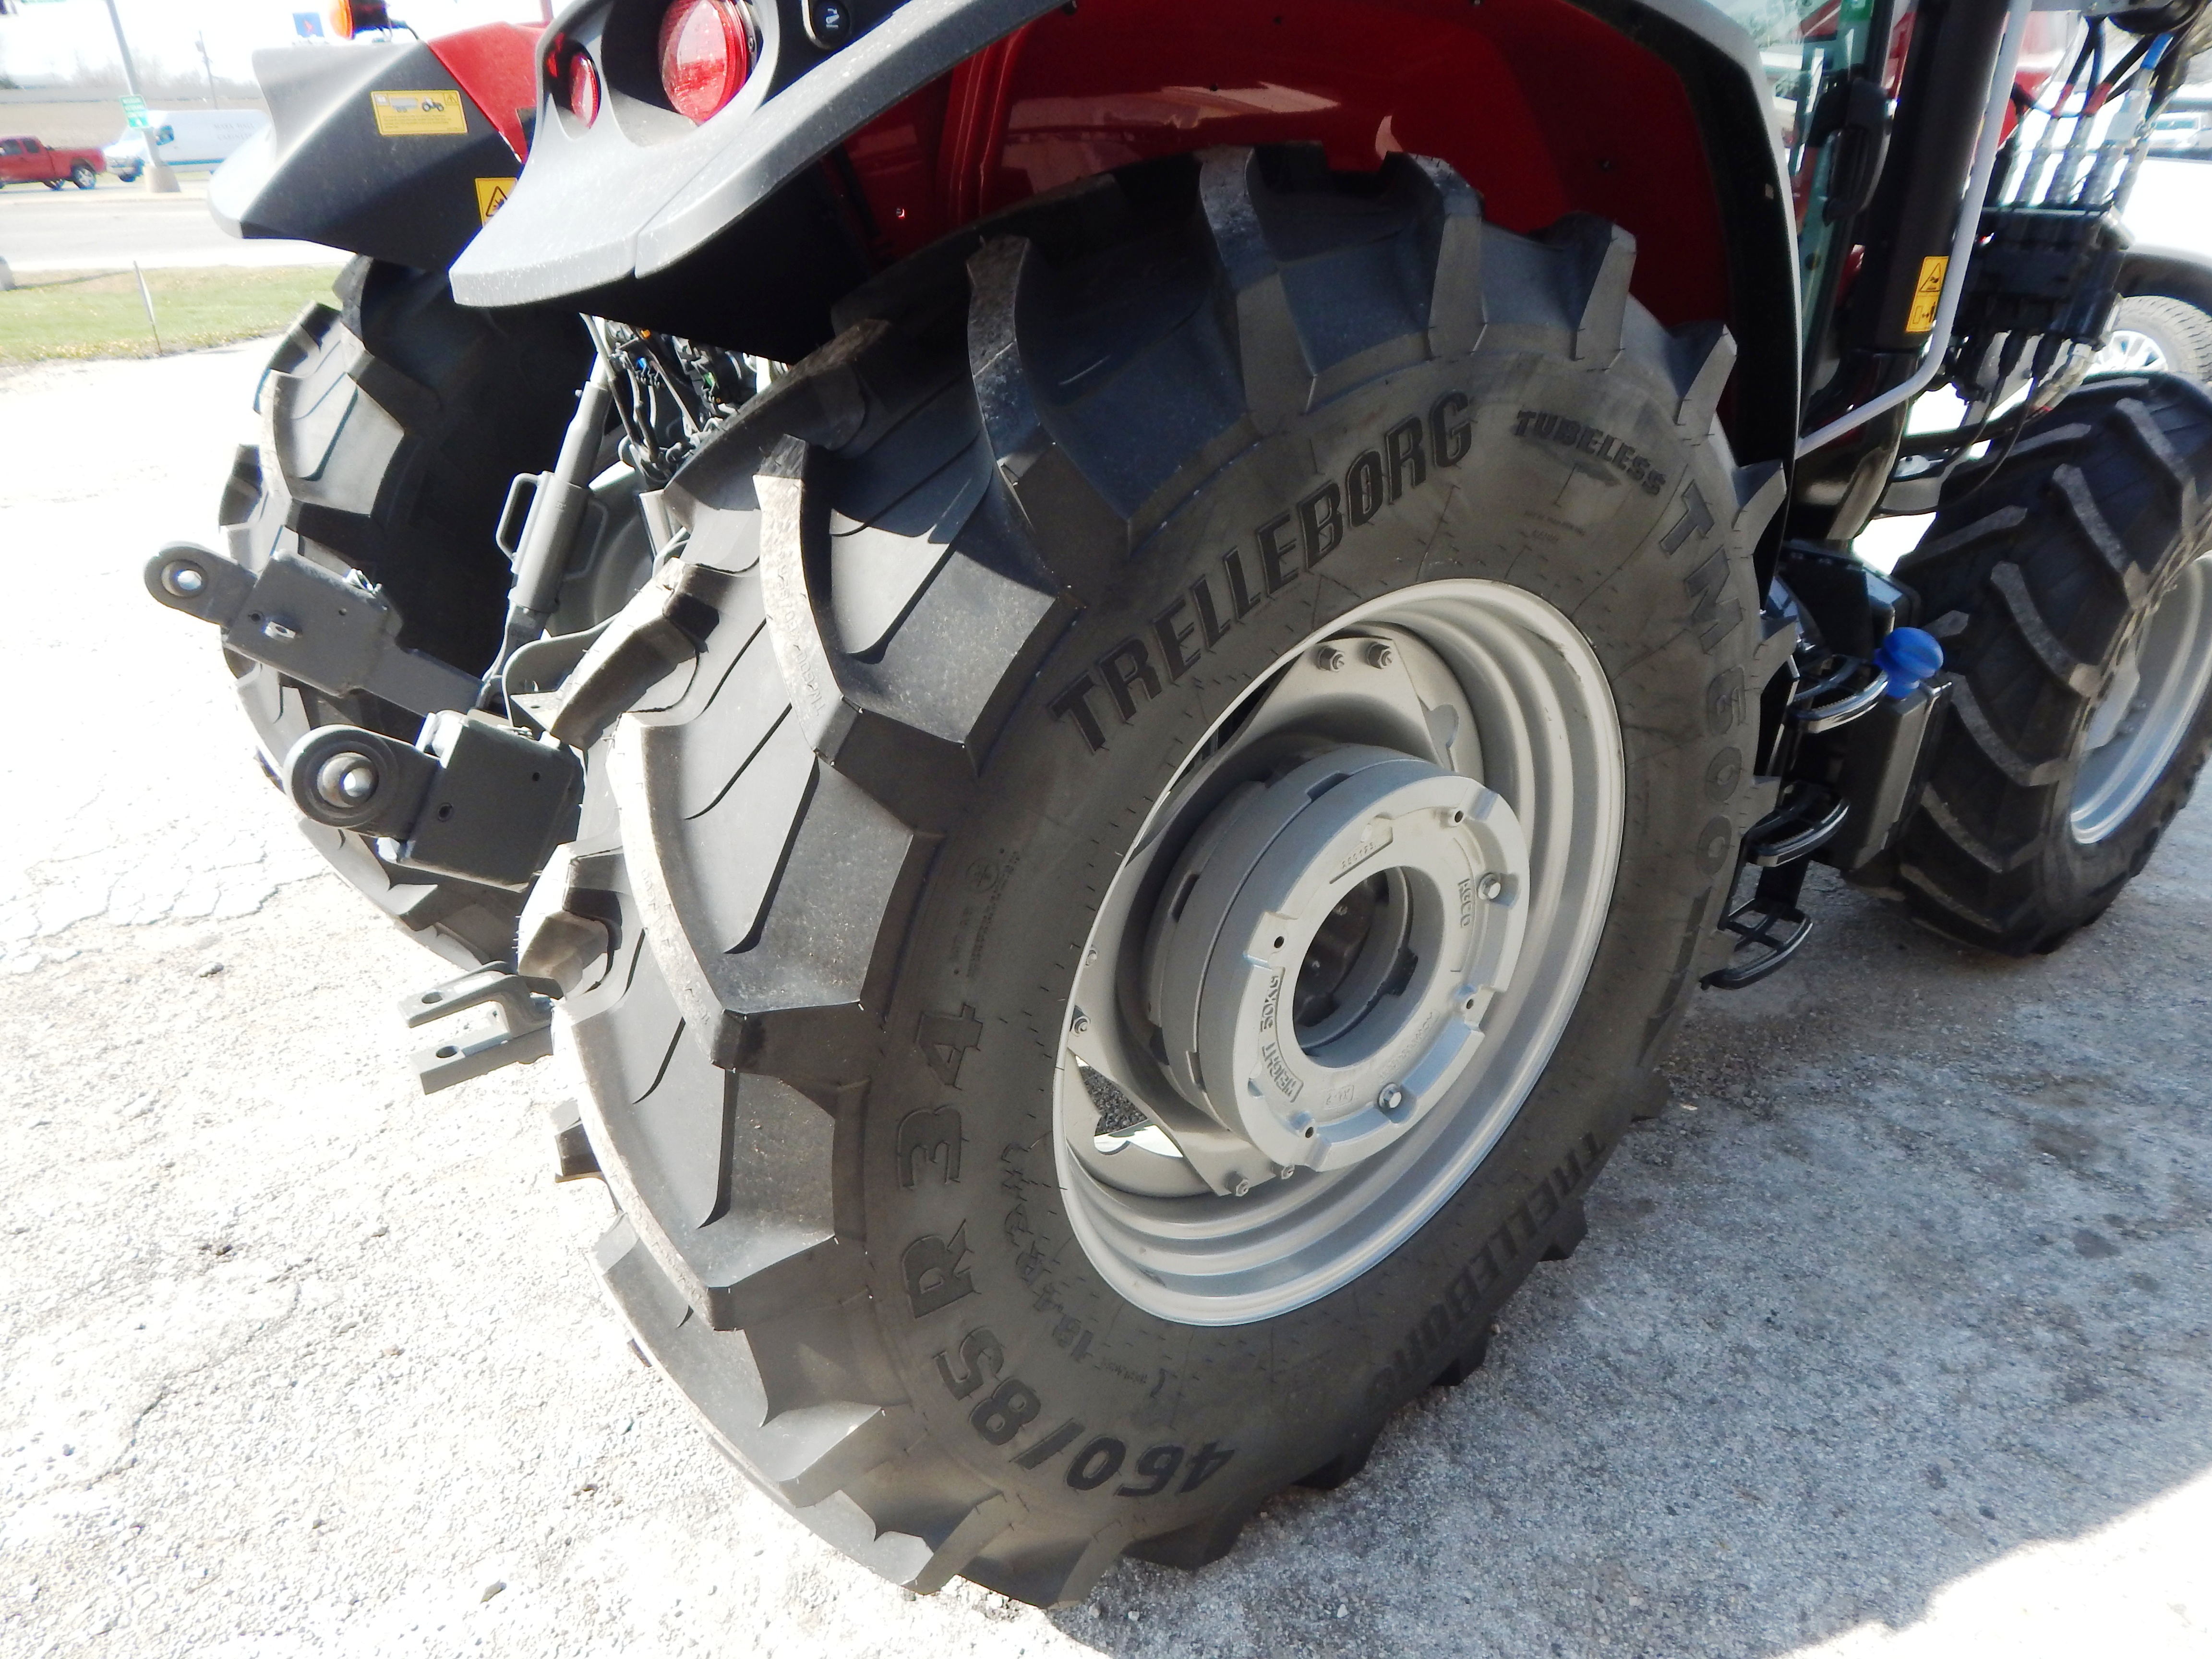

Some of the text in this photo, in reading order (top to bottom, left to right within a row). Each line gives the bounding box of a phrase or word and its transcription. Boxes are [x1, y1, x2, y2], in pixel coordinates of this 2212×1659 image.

[1515, 409, 1667, 496] TUBELESS
[1047, 389, 1473, 753] TRELLEBORG
[1458, 878, 1471, 928] AGCO
[1262, 1042, 1297, 1097] WEIGHT
[1366, 1131, 1608, 1404] TRELLEBORG
[933, 1326, 1235, 1498] 460/85
